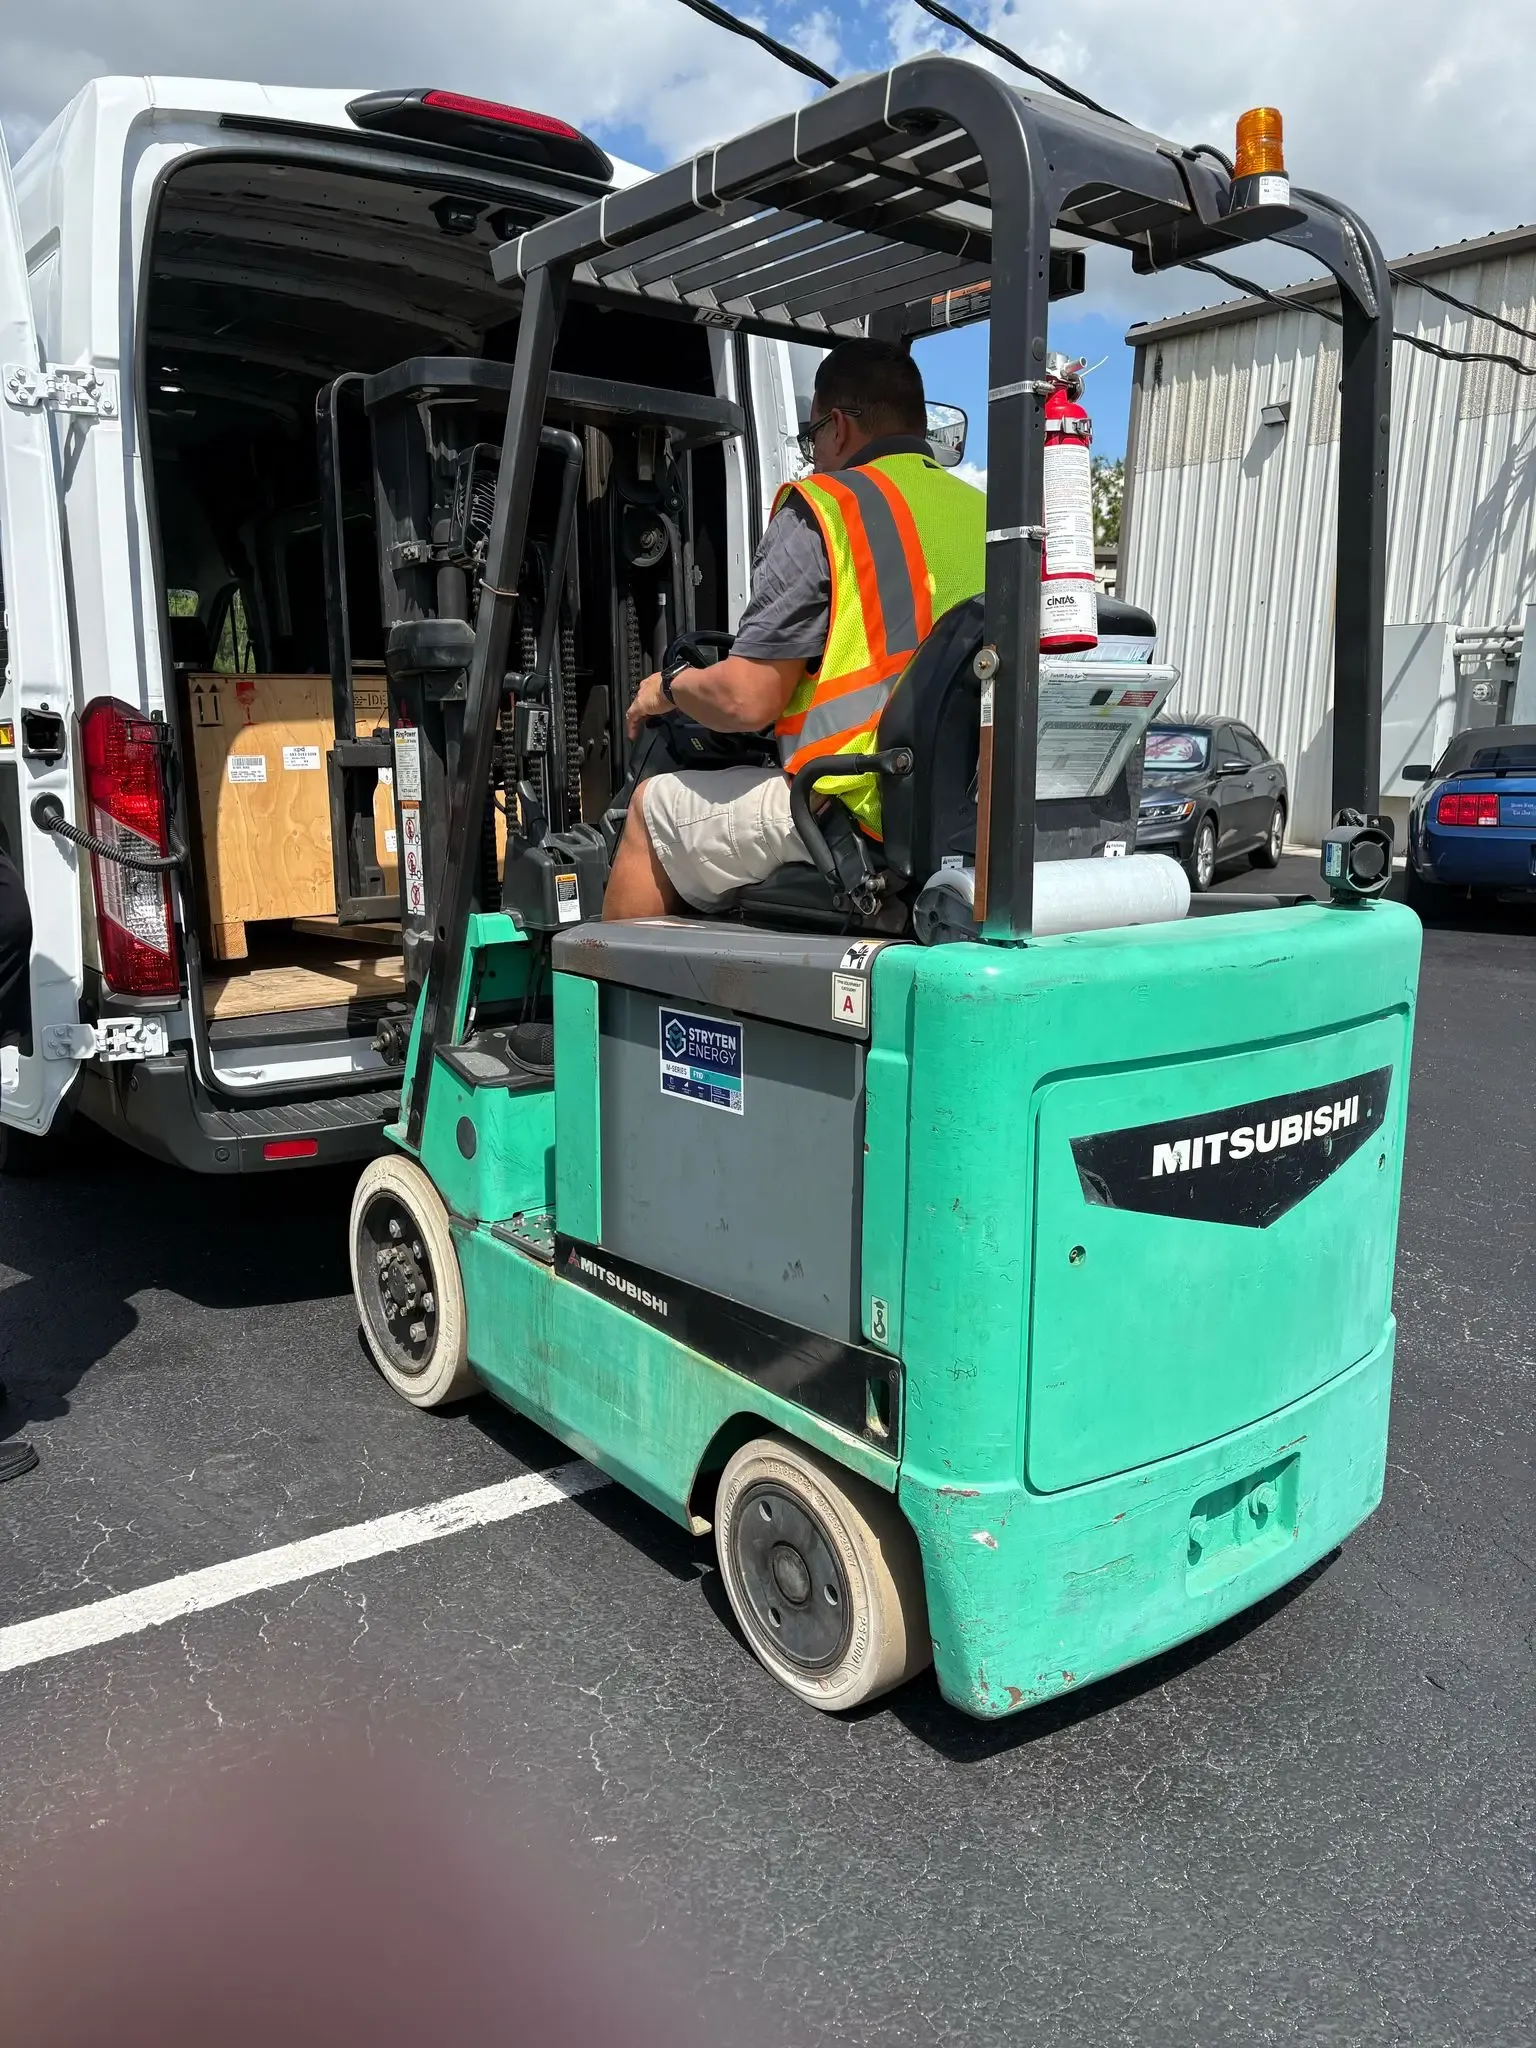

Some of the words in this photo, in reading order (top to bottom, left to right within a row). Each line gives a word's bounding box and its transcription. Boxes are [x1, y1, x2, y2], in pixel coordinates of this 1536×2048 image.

[843, 995, 854, 1013] A
[688, 1027, 737, 1050] STRYTEN
[688, 1042, 737, 1066] ENERGY
[1152, 1094, 1360, 1178] MITSUBISHI
[580, 1256, 668, 1317] MITSUBISHI
